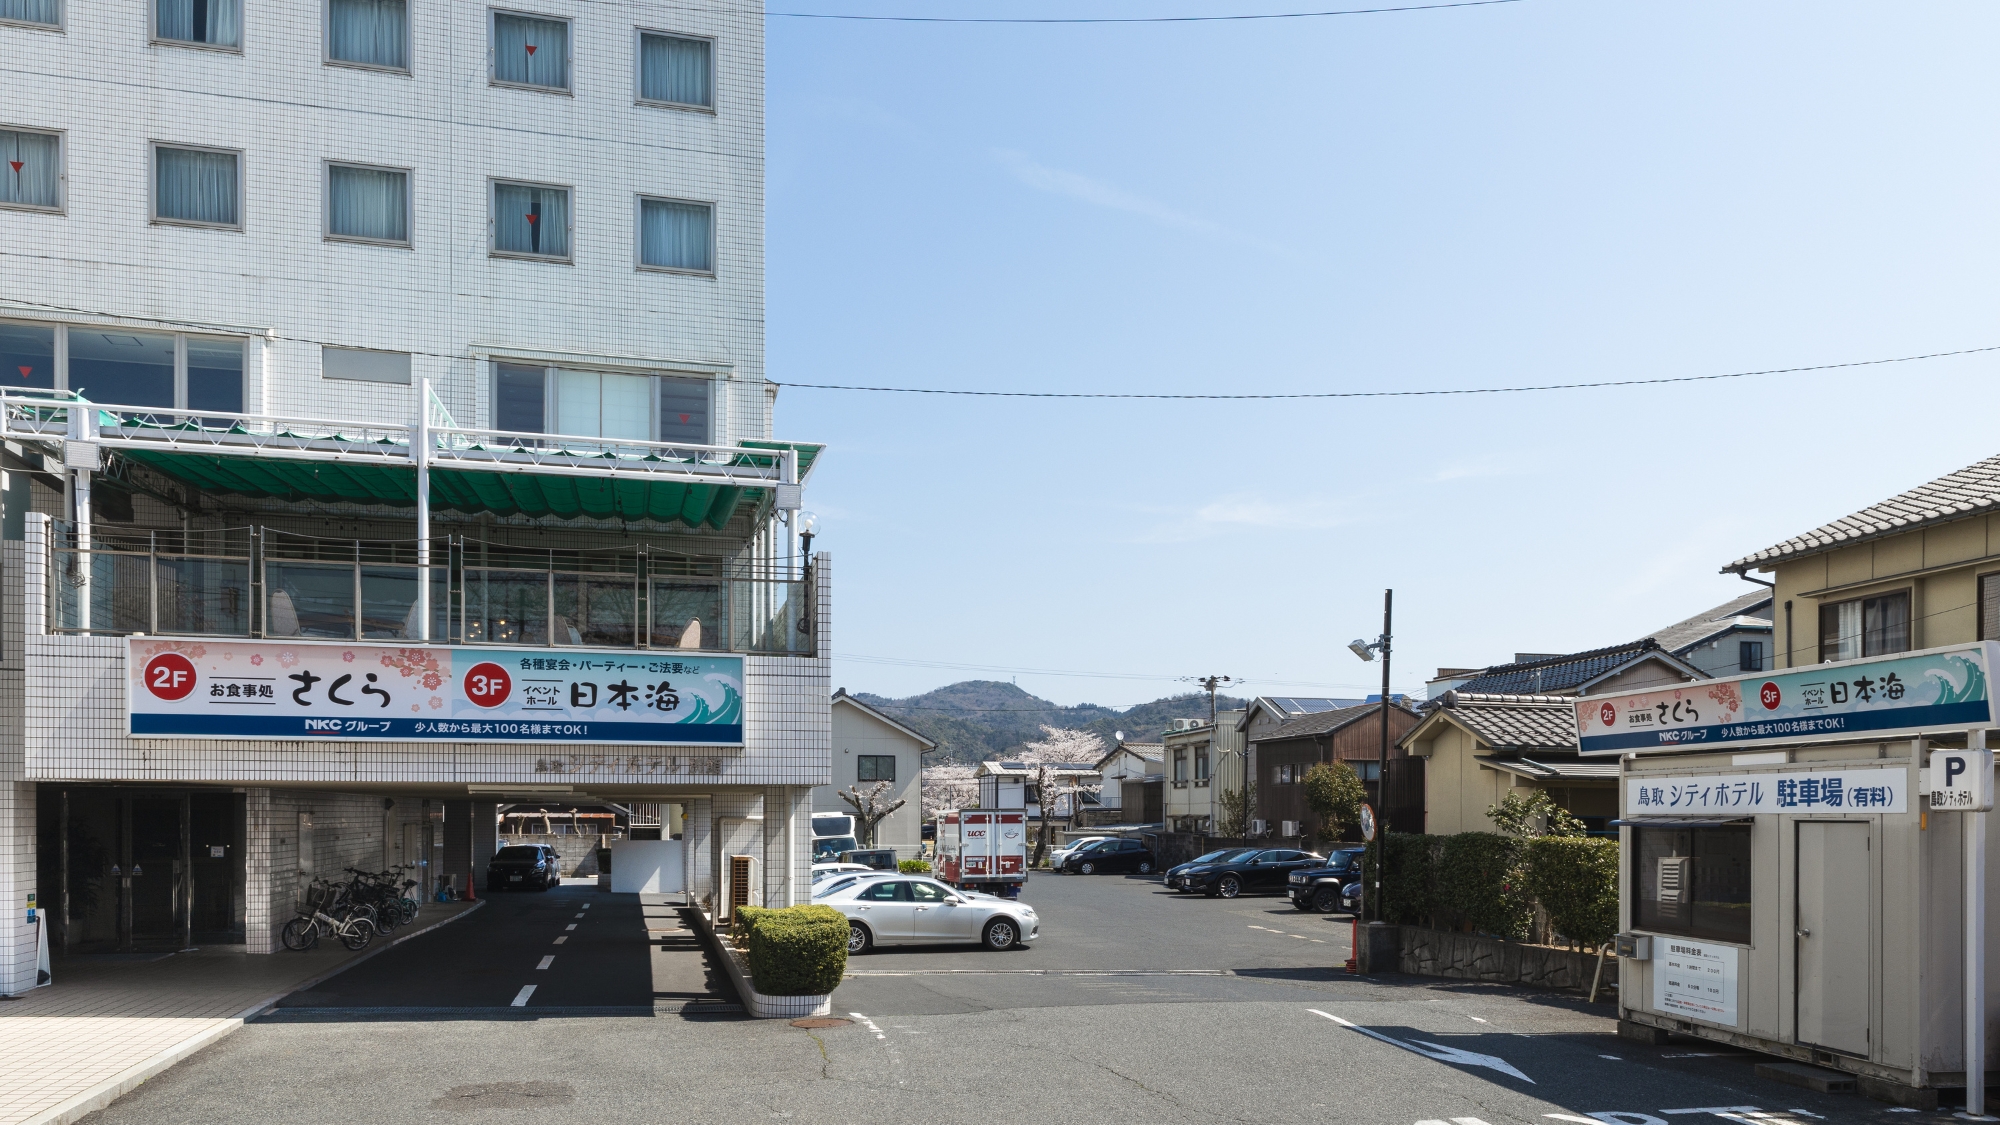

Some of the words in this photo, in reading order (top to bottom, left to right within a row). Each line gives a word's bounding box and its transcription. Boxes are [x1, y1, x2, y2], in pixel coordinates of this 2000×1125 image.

[520, 657, 700, 675] 各種宴会・パーティー・ご法要など
[153, 666, 188, 688] 2F
[209, 683, 274, 698] お食事処
[288, 669, 391, 708] さくら
[472, 675, 503, 696] 3F
[523, 685, 561, 695] イベント
[1802, 687, 1825, 698] イベント
[1829, 672, 1905, 704] 日本海
[526, 696, 558, 706] ホール
[570, 679, 680, 711] 日本海
[1763, 688, 1778, 704] 3F
[1804, 695, 1825, 705] ホール
[1602, 709, 1614, 722] 2F
[1628, 713, 1653, 724] お食事処
[1655, 699, 1699, 725] さくら
[305, 719, 342, 731] NKC
[345, 720, 391, 732] グループ
[1659, 730, 1680, 742] NKC
[1680, 729, 1708, 742] グループ
[1945, 756, 1966, 787] P
[1930, 790, 1973, 807] 鳥取シティホテル
